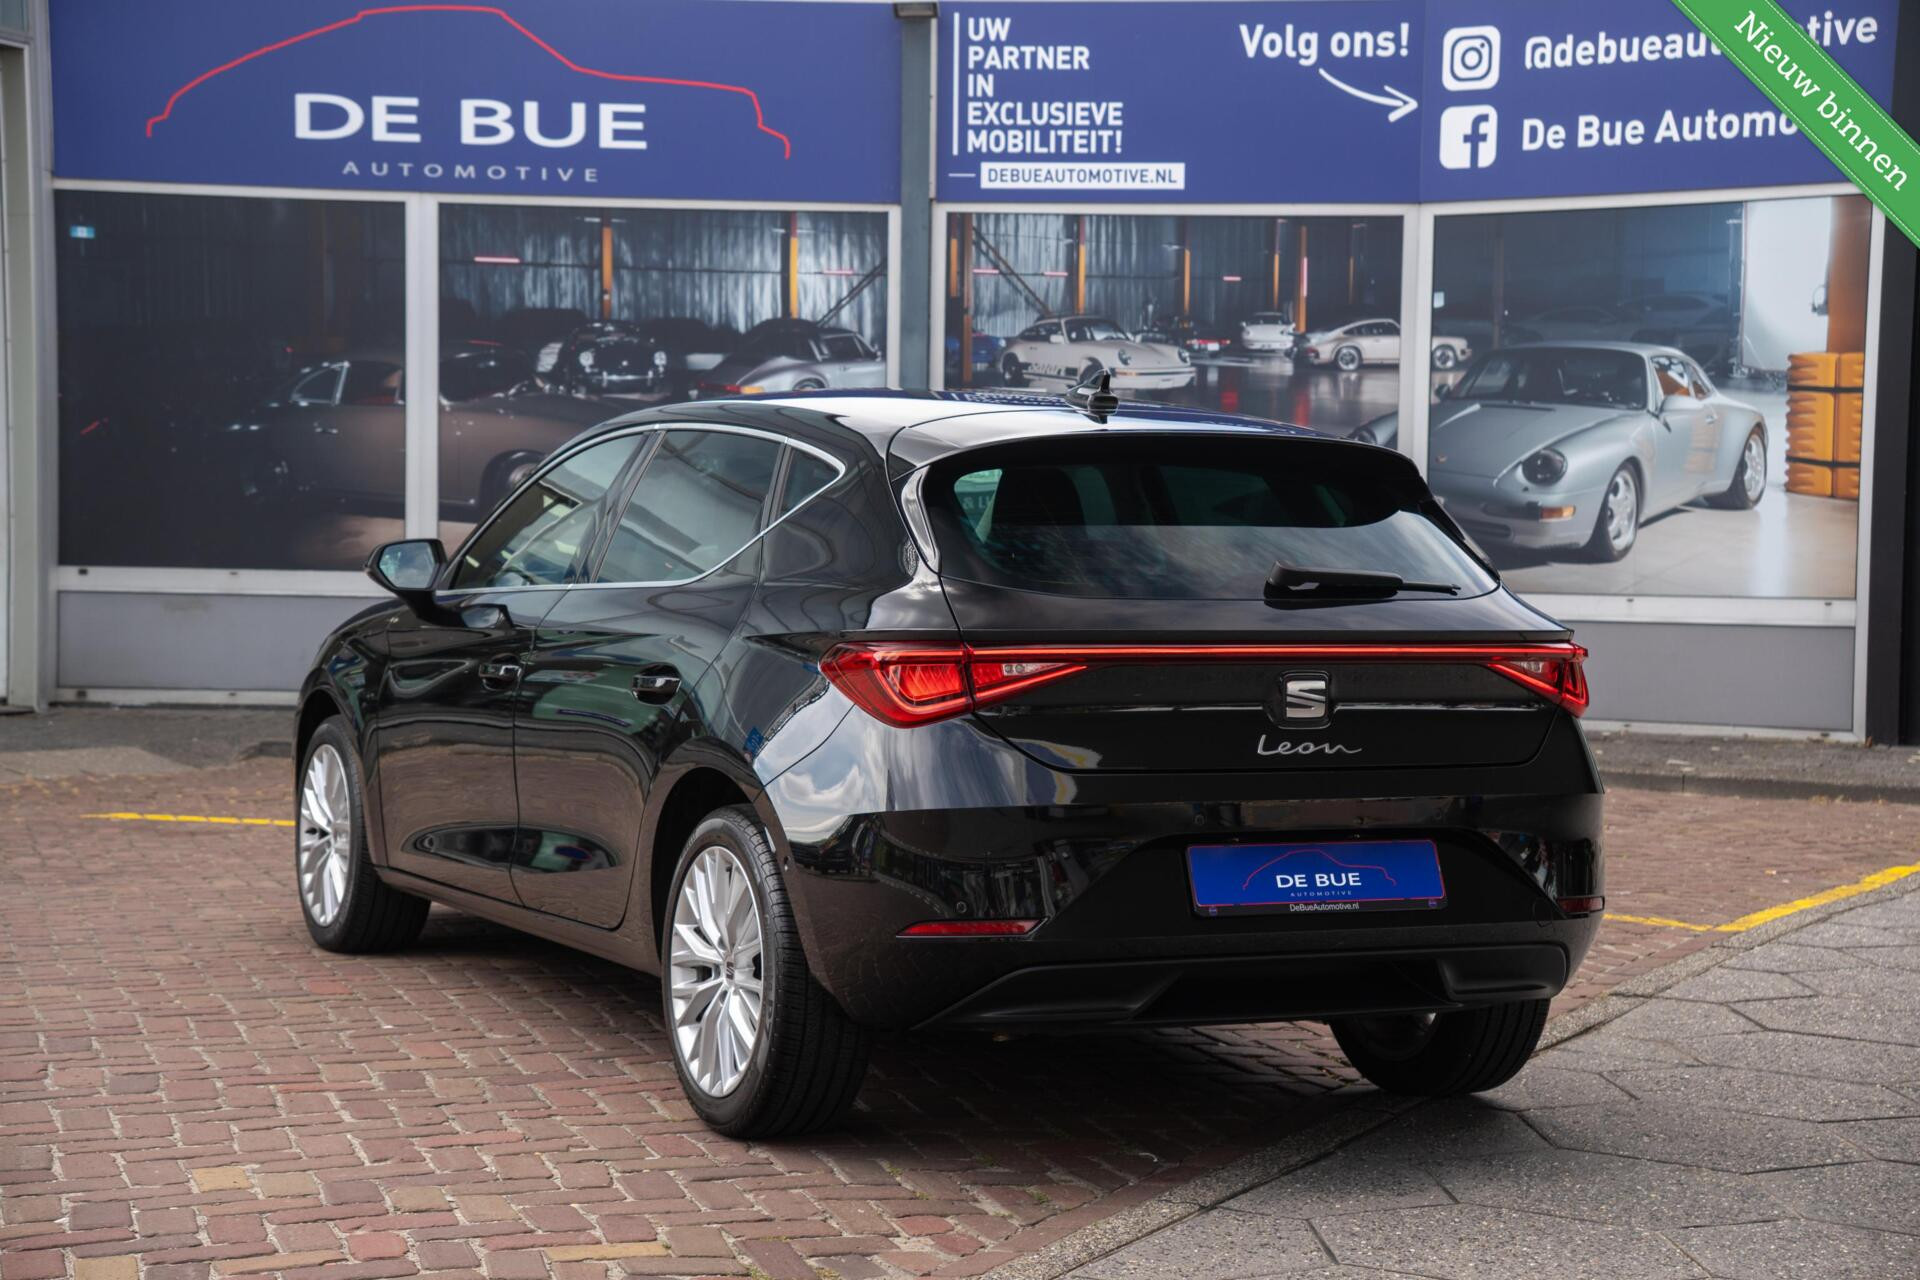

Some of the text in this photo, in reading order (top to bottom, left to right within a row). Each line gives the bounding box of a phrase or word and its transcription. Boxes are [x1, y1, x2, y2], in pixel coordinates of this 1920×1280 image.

[967, 16, 1011, 42] UW
[1239, 22, 1409, 66] Volg ons!
[967, 45, 1090, 71] PARTNER
[967, 73, 994, 98] IN
[295, 92, 648, 150] DE BUE
[967, 101, 1123, 127] EXCLUSIEVE
[966, 129, 1122, 155] MOBILITEIT!
[1522, 108, 1799, 151] De Bue Automo
[342, 160, 598, 183] AUTOMOTIVE
[987, 168, 1178, 184] DEBUEAUTOMOTIVE.NL
[1257, 734, 1363, 756] Leon
[1275, 872, 1362, 889] DE BUE
[1289, 902, 1360, 912] DeBueAutomotive.nl
